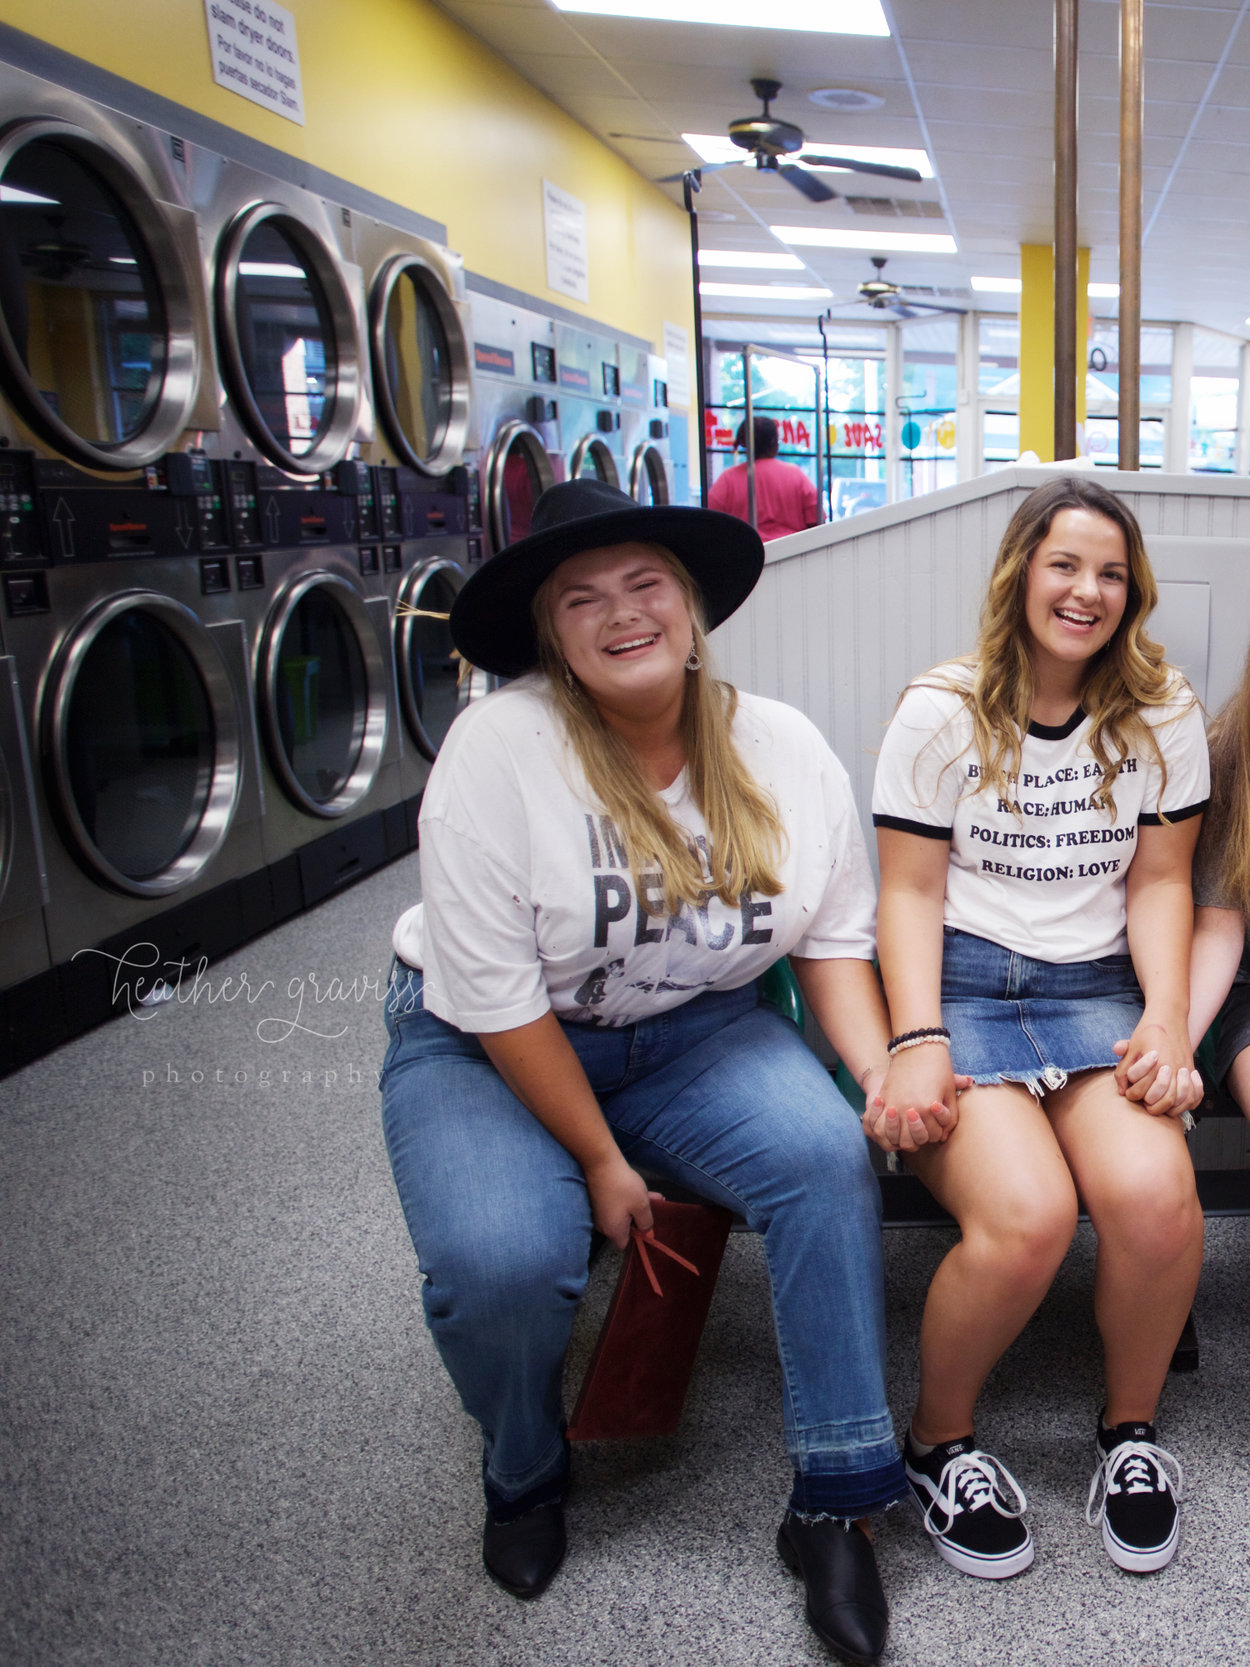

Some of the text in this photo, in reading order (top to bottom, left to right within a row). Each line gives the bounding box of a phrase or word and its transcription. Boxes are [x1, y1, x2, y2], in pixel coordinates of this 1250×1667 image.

[1023, 767, 1079, 788] PLACE:
[970, 824, 1135, 848] POLITICS: FREEDOM
[982, 859, 1121, 882] RELIGION: LOVE
